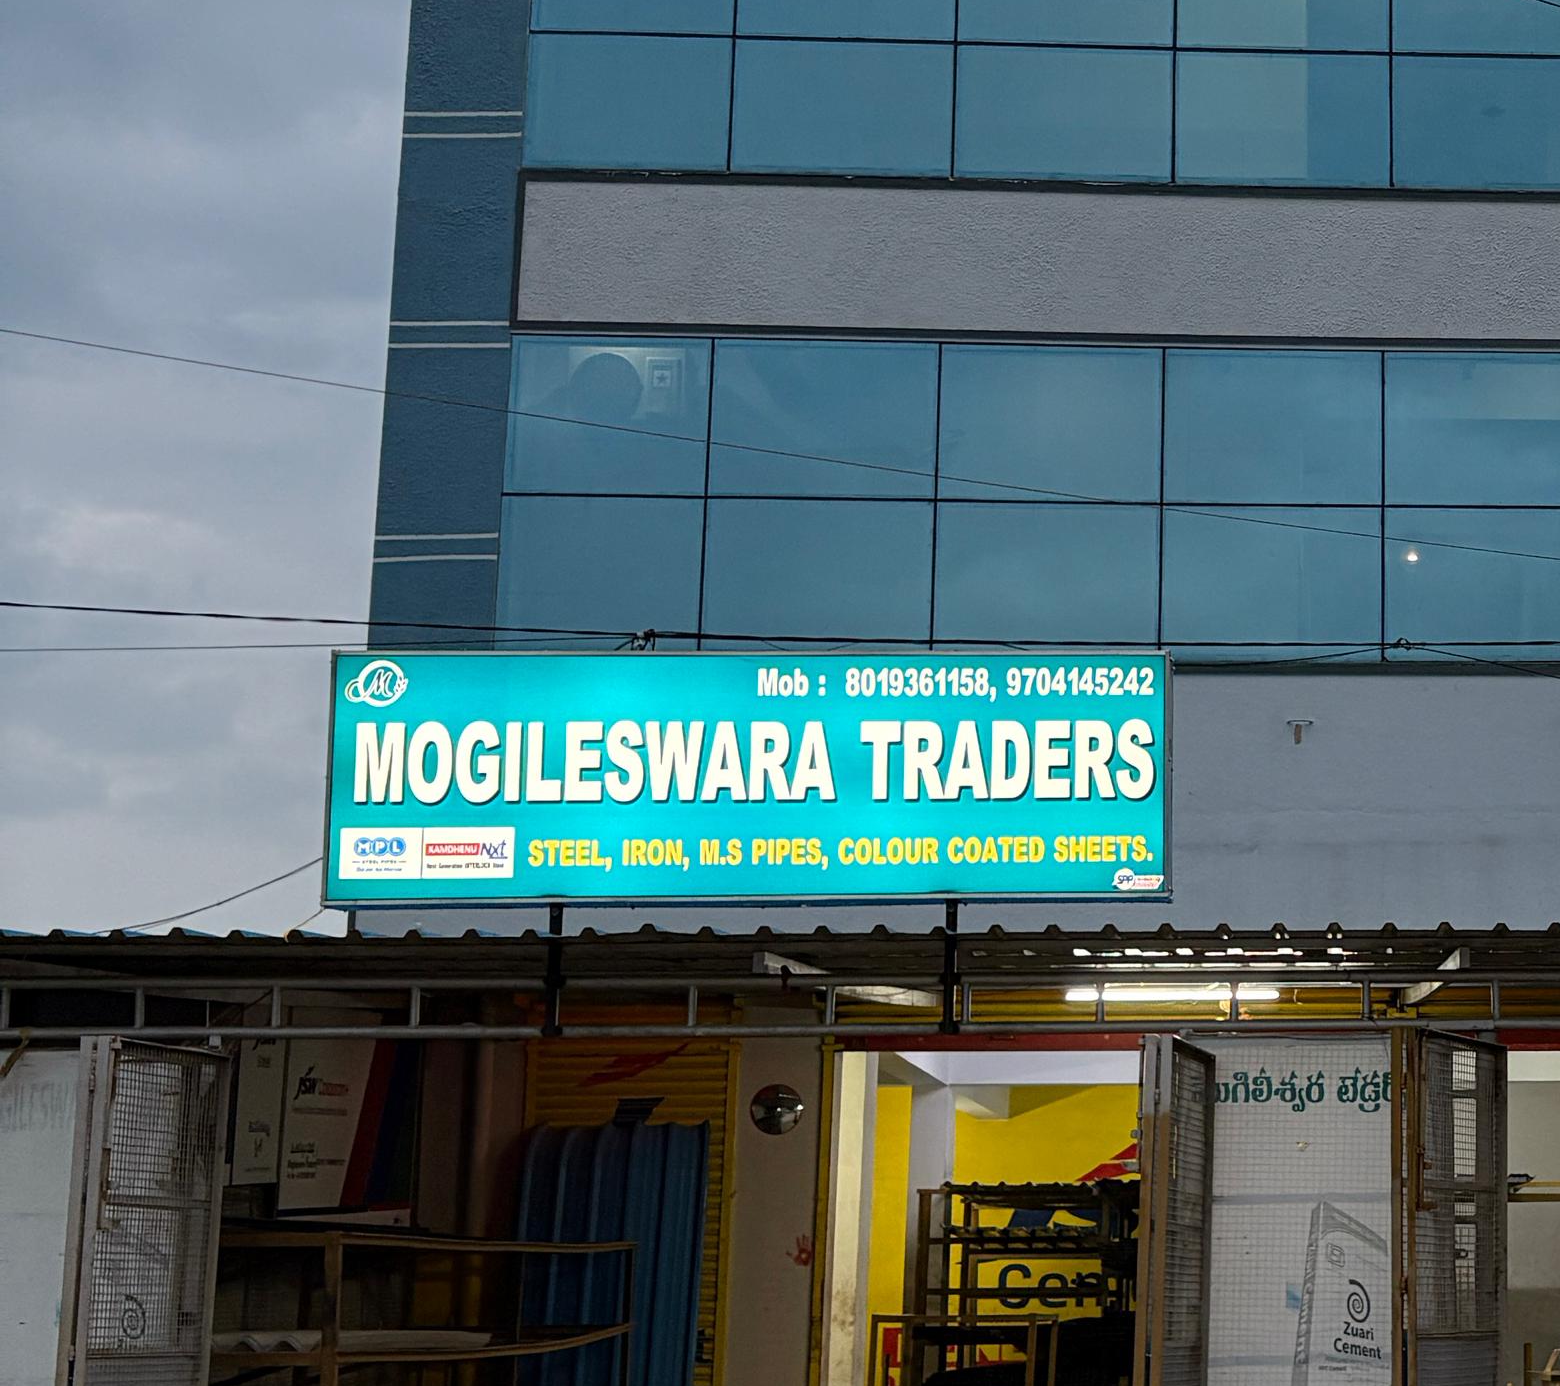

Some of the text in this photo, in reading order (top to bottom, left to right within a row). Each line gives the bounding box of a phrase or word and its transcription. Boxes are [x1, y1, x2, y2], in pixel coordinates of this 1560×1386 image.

[757, 668, 809, 696] Mob
[845, 667, 997, 702] 8019361158,
[1006, 667, 1154, 696] 9704145242
[353, 718, 1154, 804] MOGILESWARA TRADERS
[355, 838, 404, 856] MPL
[427, 844, 478, 854] KAMDHENU
[527, 834, 1154, 871] STEEL, IRON, M.S PIPES, COLOUR COATED SHEETS.
[1343, 1322, 1375, 1341] Zuari
[1333, 1338, 1382, 1360] Cement
